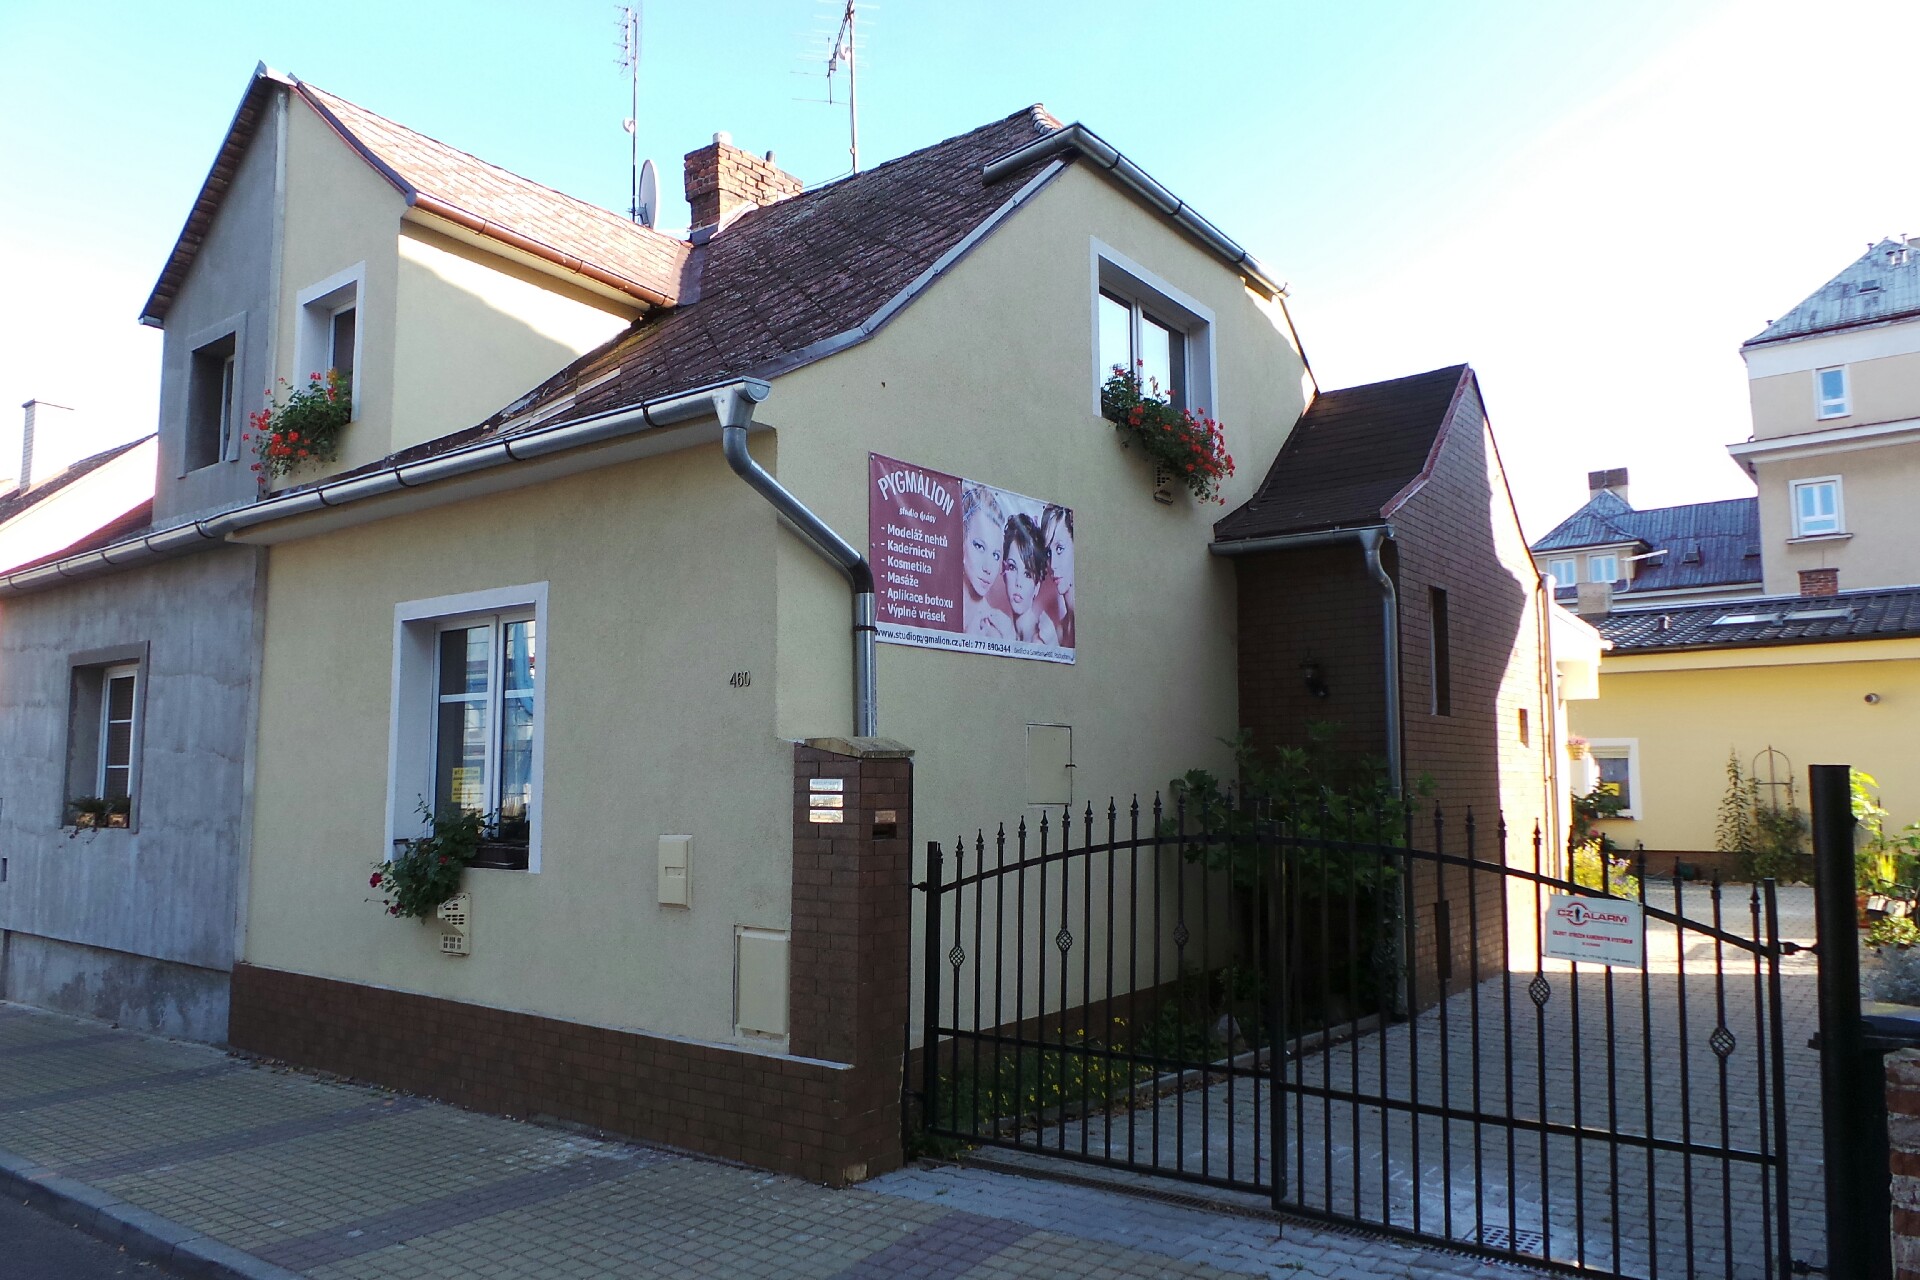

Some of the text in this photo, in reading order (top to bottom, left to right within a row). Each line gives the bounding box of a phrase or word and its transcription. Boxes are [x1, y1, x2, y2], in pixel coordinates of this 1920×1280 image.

[877, 470, 955, 516] PYGMALION
[887, 523, 948, 548] Modeláž nehtů
[887, 539, 936, 560] Kadeřnictví
[887, 555, 932, 575] Kosmetika
[887, 571, 919, 588] Masáže
[887, 587, 954, 609] Aplikace botoxu
[887, 602, 946, 623] Výplně vrásek
[974, 640, 986, 650] 777
[729, 670, 751, 689] 460
[1557, 909, 1574, 917] CZ
[1582, 912, 1628, 923] ALARM
